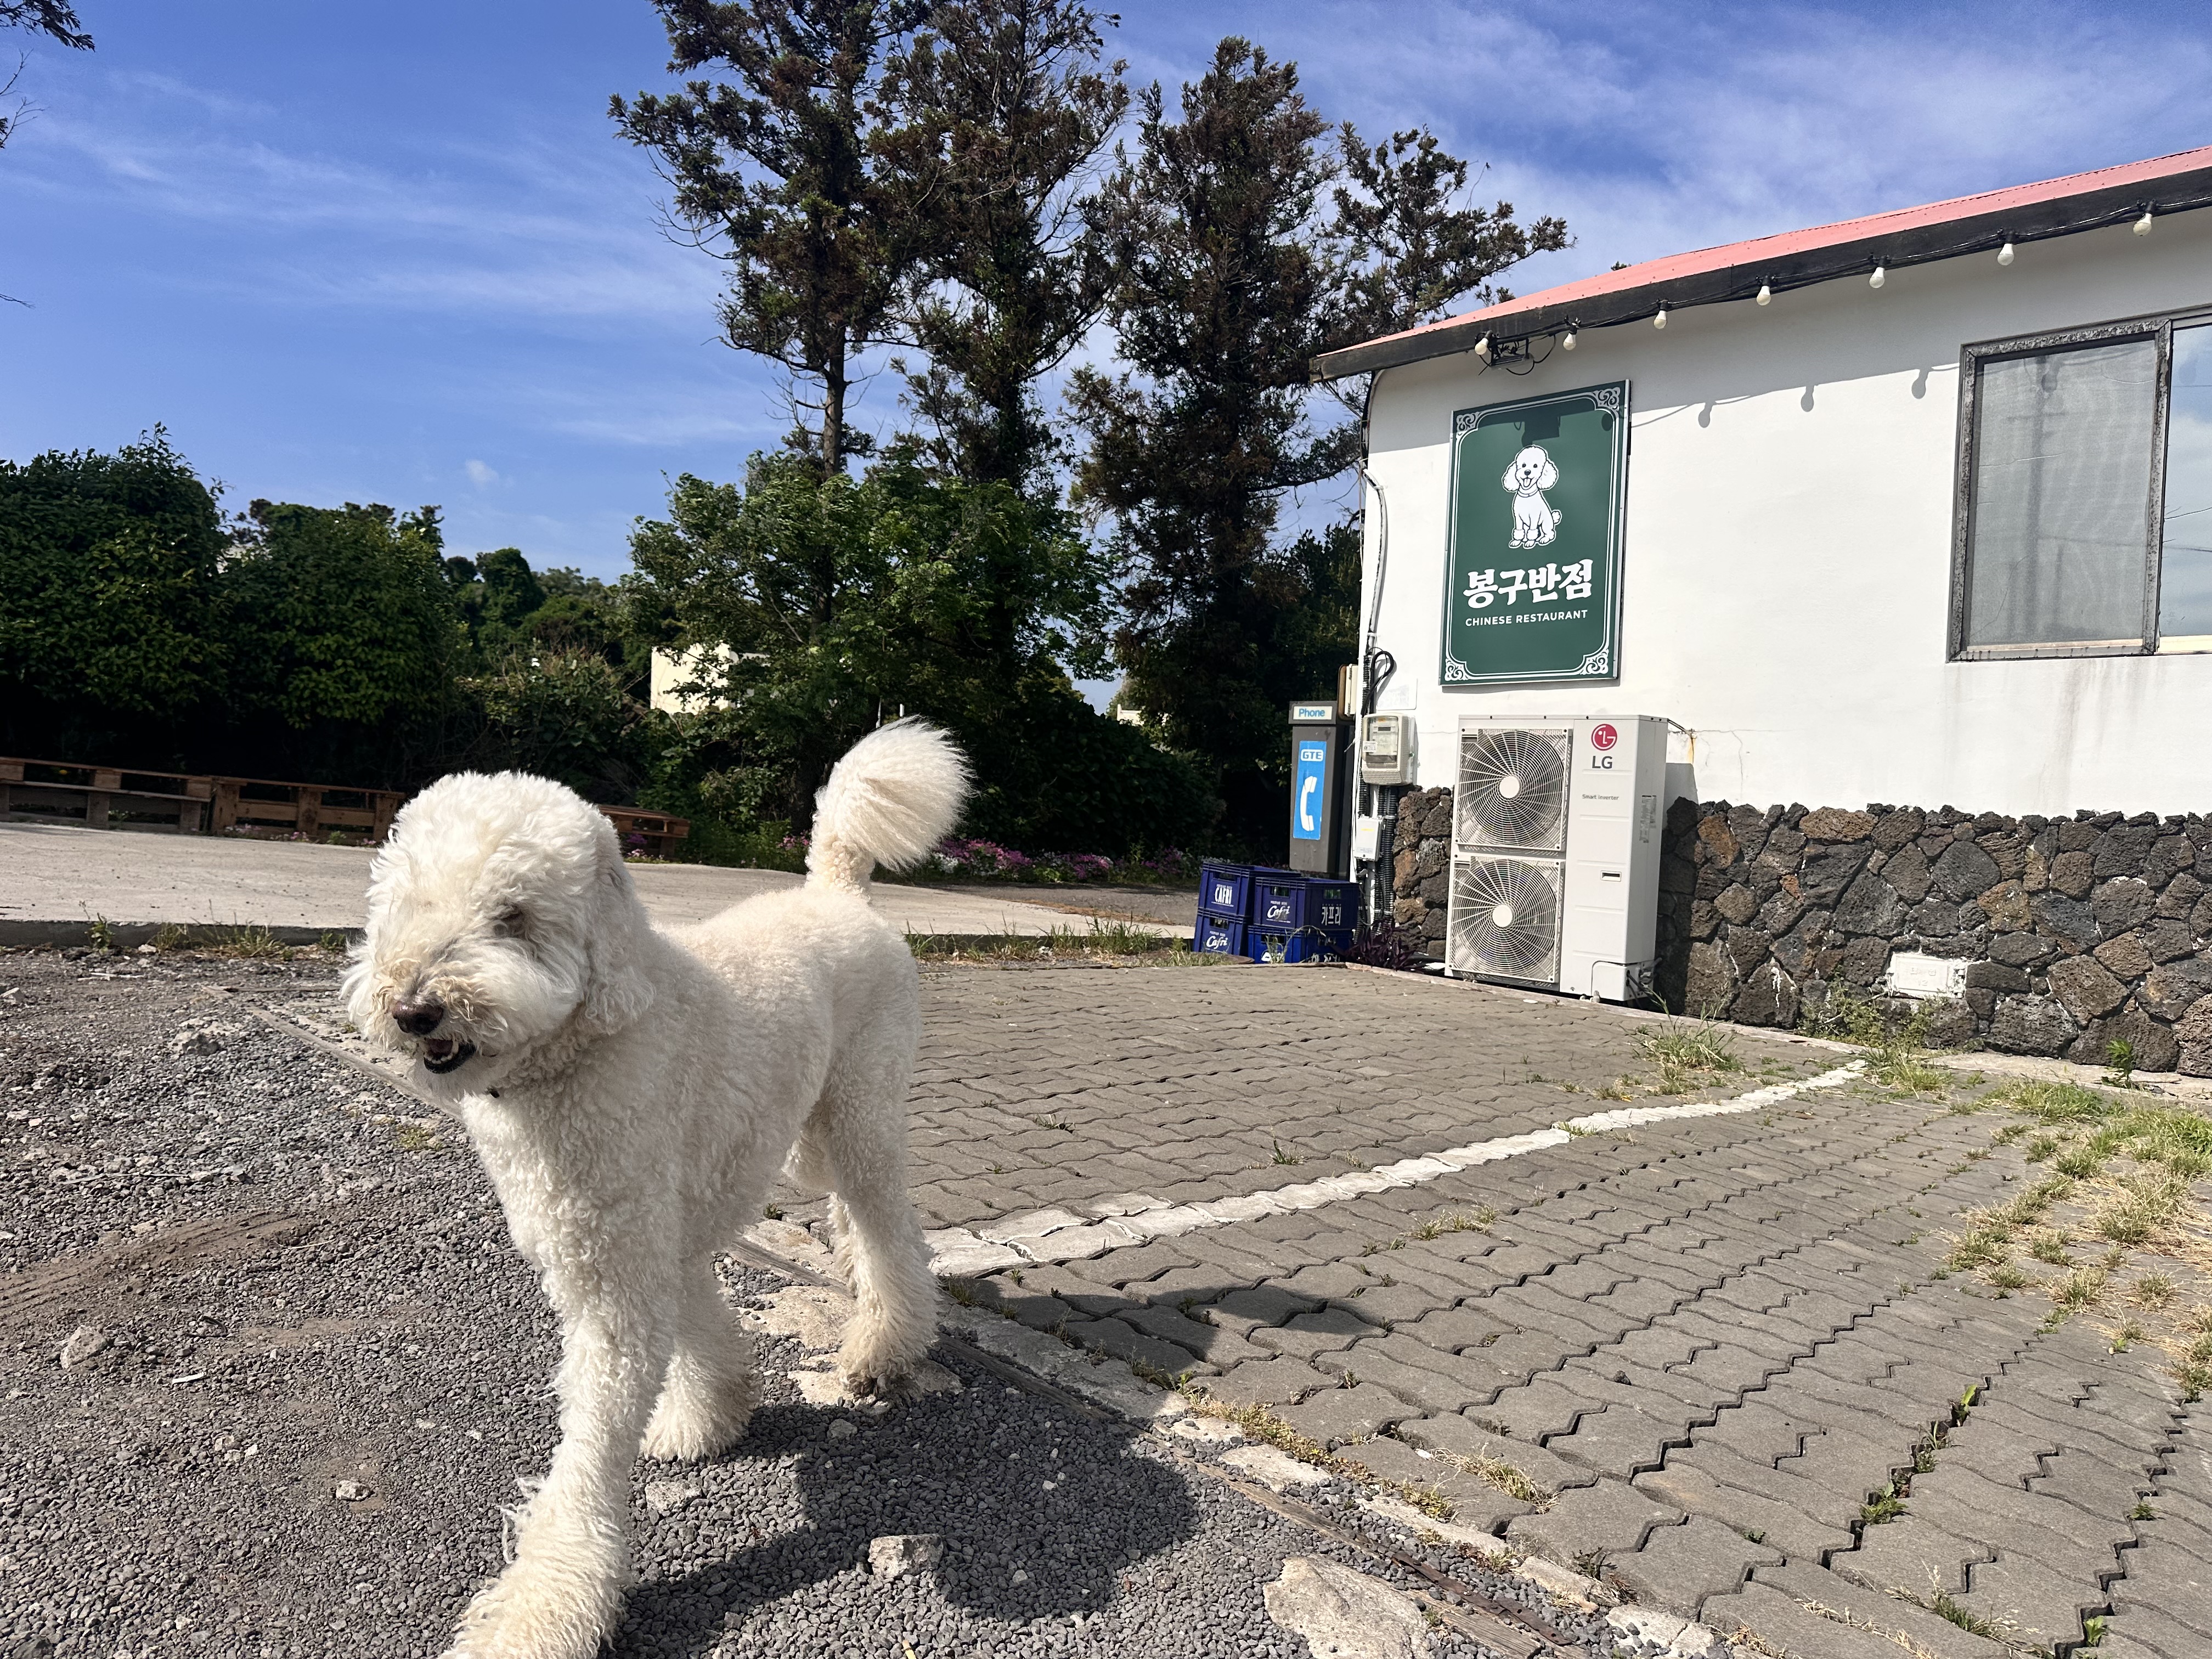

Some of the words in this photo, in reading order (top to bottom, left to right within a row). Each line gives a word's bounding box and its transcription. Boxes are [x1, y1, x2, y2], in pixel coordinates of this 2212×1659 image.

[1463, 558, 1593, 608] 봉구반점
[1465, 616, 1512, 627] CHINESE
[1516, 610, 1588, 623] RESTAURANT
[1299, 708, 1325, 717] Phone
[1302, 751, 1322, 760] GTE
[1592, 755, 1613, 769] LG
[1215, 887, 1232, 905] CAFRI
[1267, 905, 1290, 919] Cafri
[1321, 906, 1341, 926] 카프리
[1206, 935, 1228, 949] Cafri
